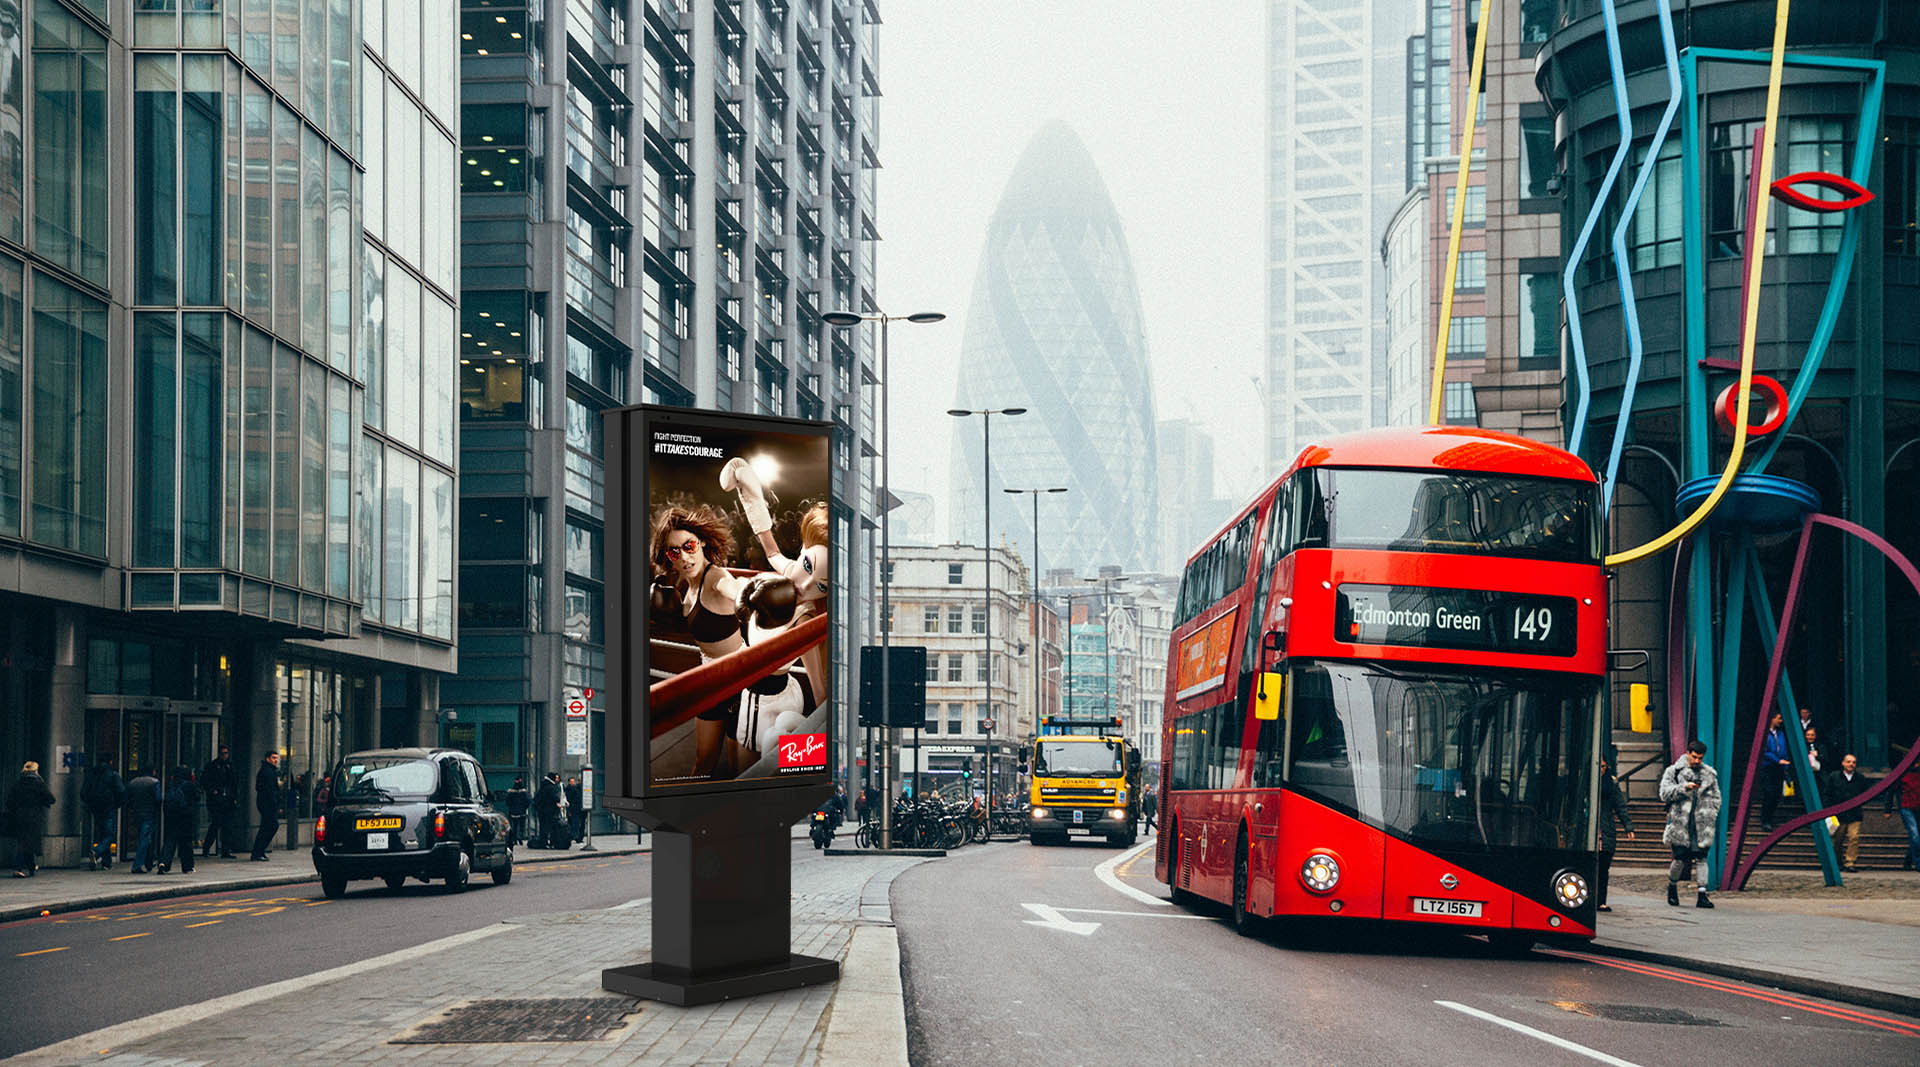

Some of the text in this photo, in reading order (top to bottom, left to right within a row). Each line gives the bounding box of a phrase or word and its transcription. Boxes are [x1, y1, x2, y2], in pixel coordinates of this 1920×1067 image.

[654, 443, 724, 459] #ITTAKESCOURAGE
[1353, 602, 1553, 642] Edmonton Green 149
[780, 735, 825, 763] Ray-Ban
[1420, 899, 1475, 915] LTZ 1567
